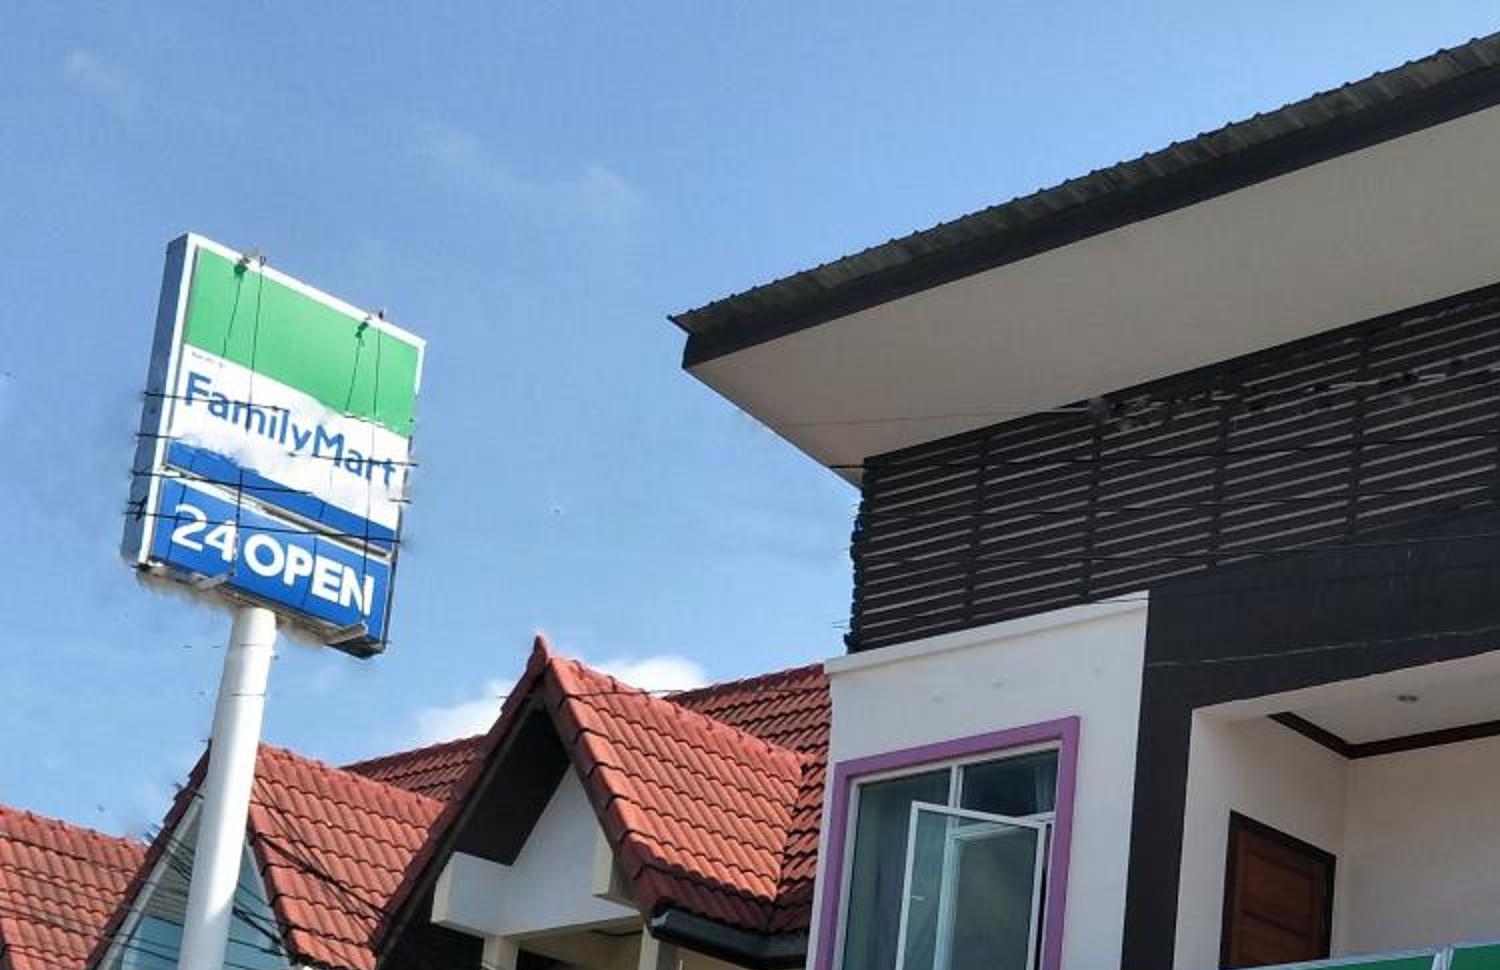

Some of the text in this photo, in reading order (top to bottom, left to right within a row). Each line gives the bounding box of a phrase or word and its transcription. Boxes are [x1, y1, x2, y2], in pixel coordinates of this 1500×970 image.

[184, 371, 397, 489] FamilyMart
[171, 504, 376, 616] 24 OPEN
